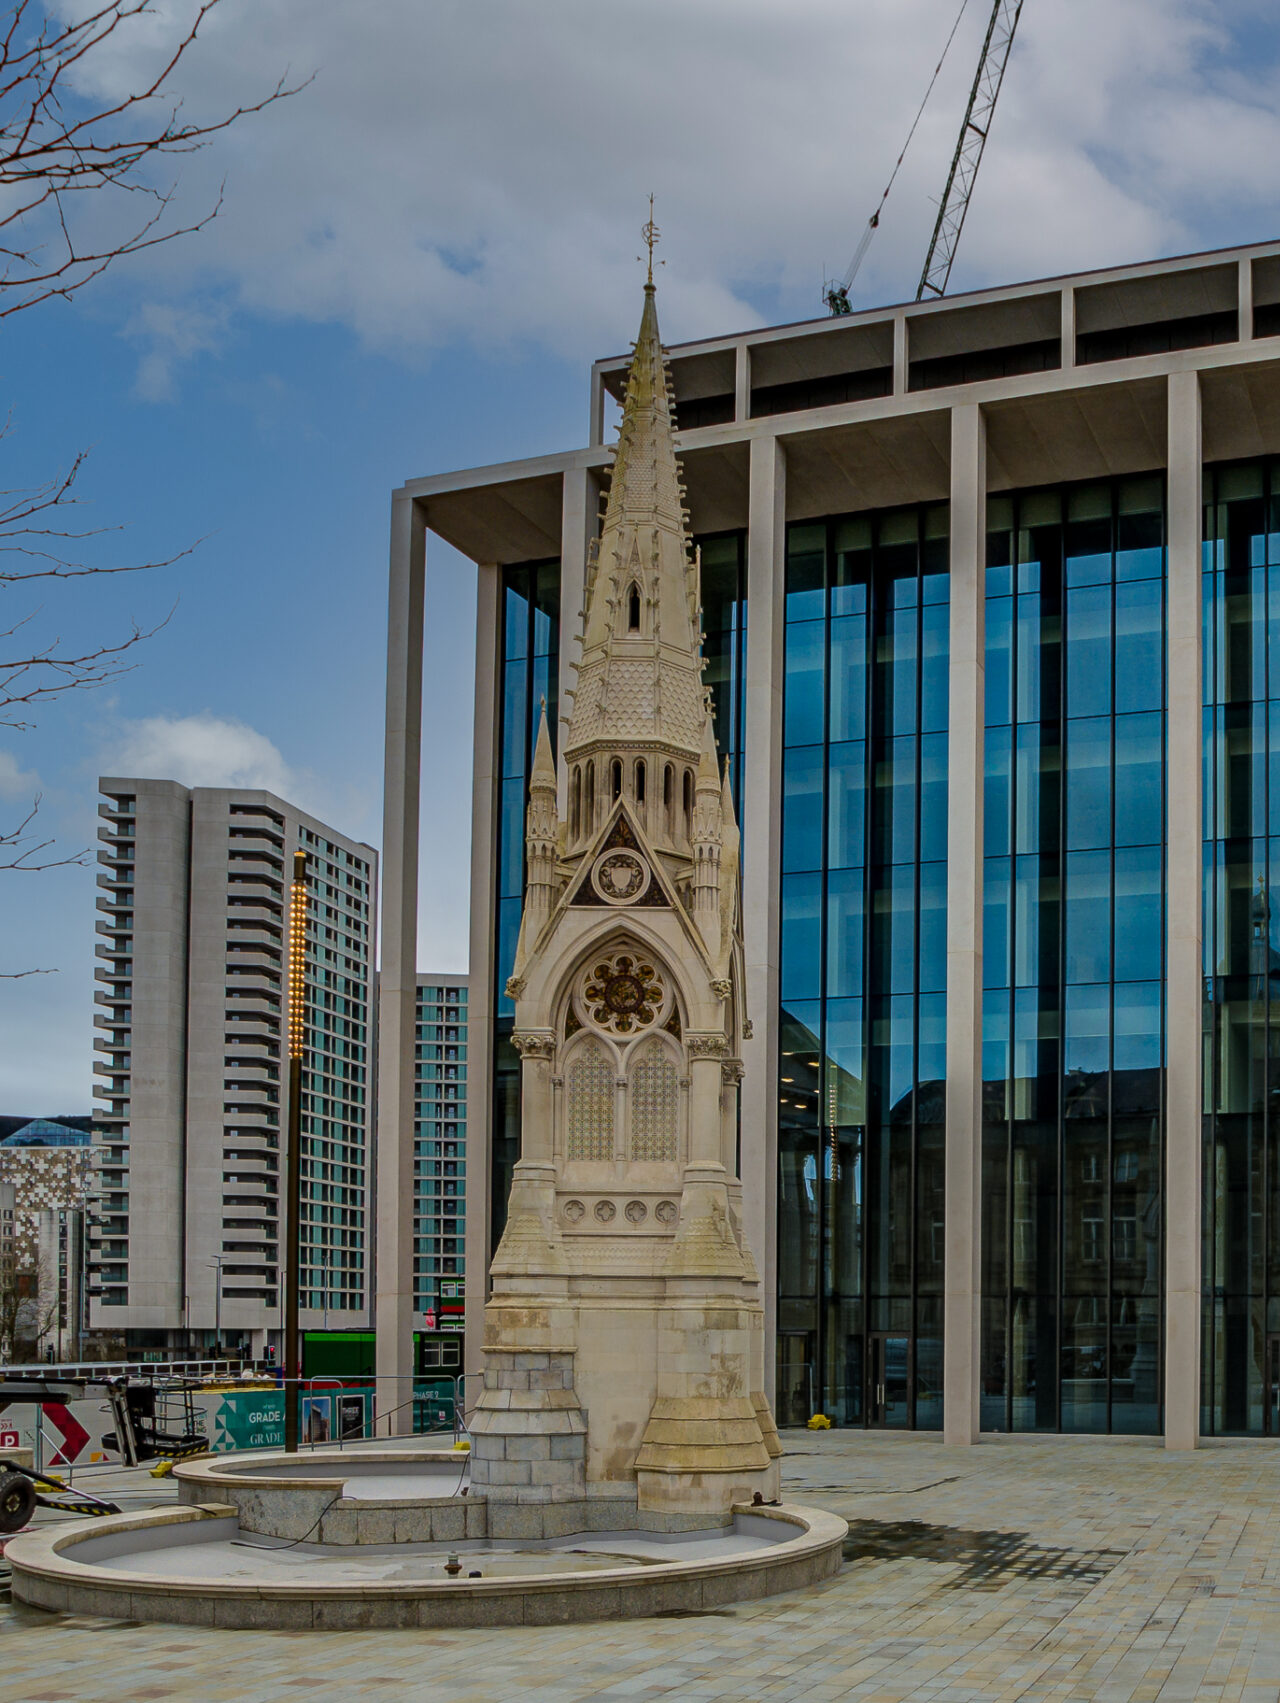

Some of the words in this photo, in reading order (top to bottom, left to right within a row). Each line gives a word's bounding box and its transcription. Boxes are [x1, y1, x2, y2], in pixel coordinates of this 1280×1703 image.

[248, 1410, 281, 1424] GRADE
[4, 1435, 16, 1447] P
[250, 1432, 284, 1445] GRADE
